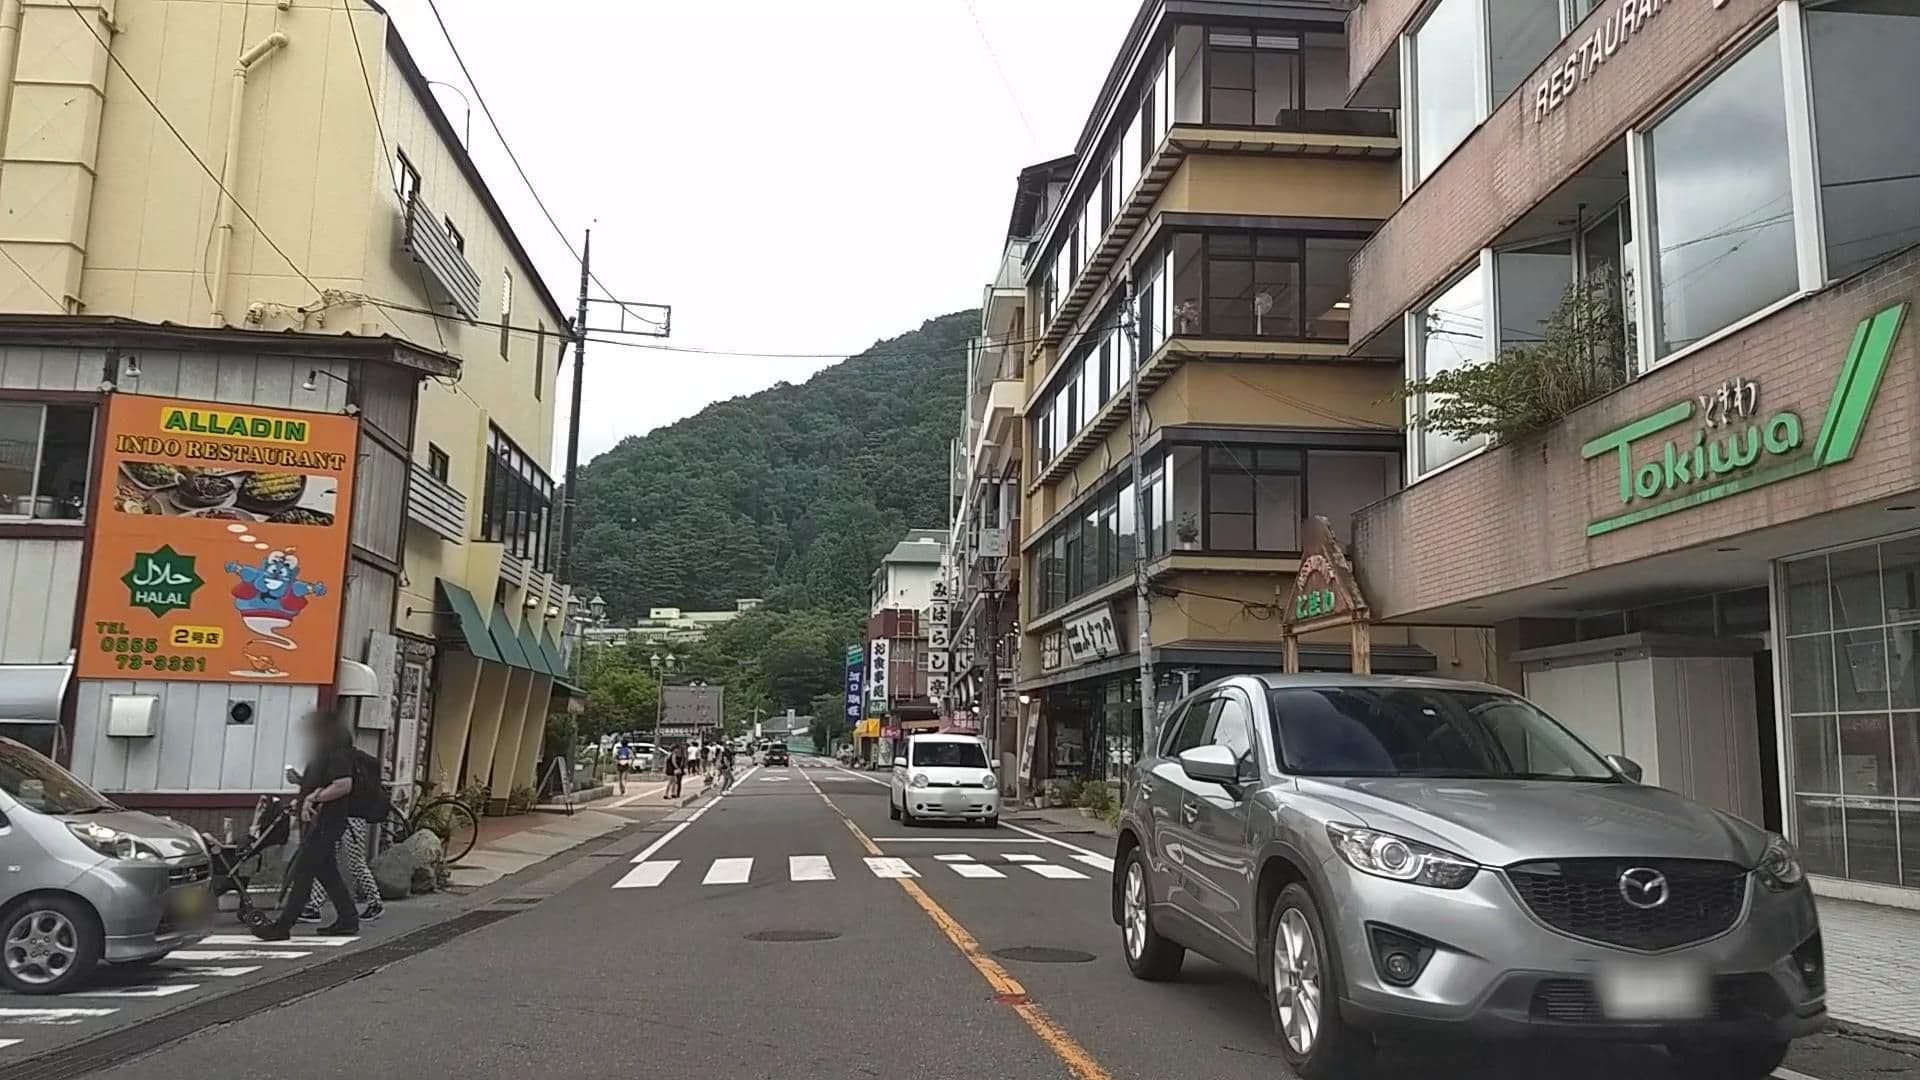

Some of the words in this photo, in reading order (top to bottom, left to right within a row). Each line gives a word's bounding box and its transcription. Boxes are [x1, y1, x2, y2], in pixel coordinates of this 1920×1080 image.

[1699, 376, 1759, 427] ときわ
[165, 410, 306, 441] ALLADIN
[115, 433, 180, 457] INDO
[186, 442, 346, 471] RESTAURANT
[1582, 400, 1803, 504] Tokiwa
[132, 558, 193, 585] حلال
[135, 591, 187, 605] HALAL
[96, 621, 129, 635] TEL
[174, 629, 220, 644] 2号店
[930, 582, 948, 696] みはらし亭
[101, 636, 158, 653] 0555
[115, 654, 207, 672] 73-3331
[873, 642, 886, 698] お食事処
